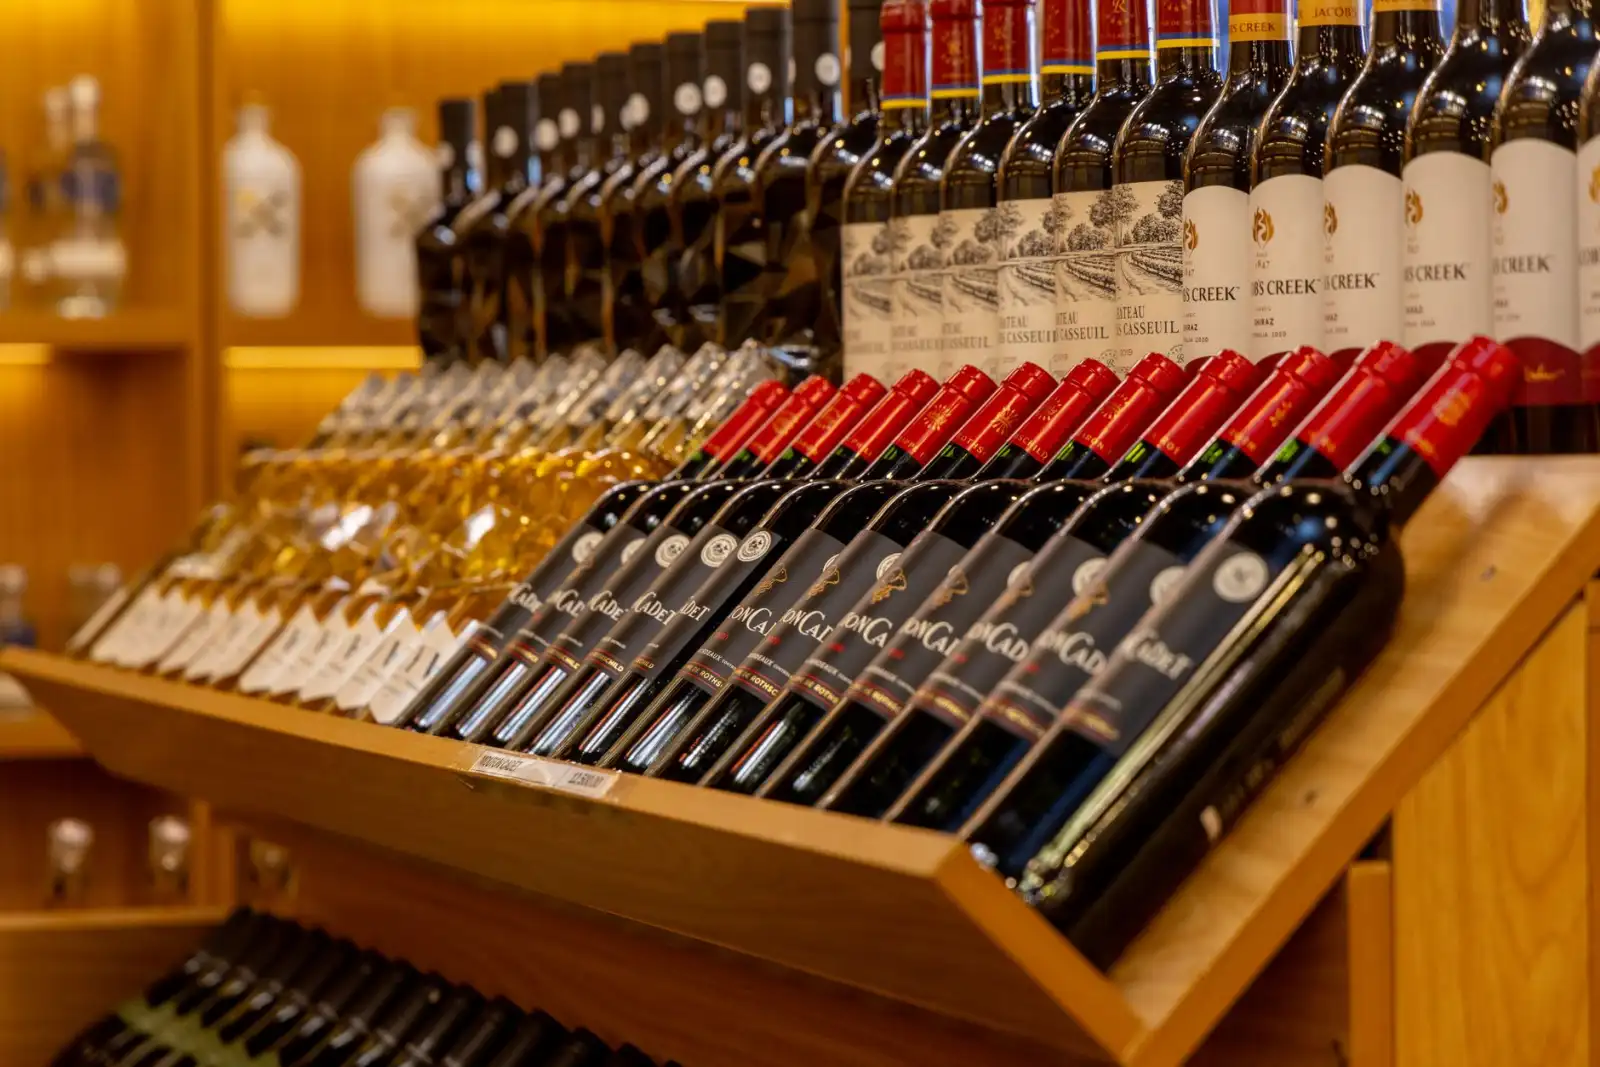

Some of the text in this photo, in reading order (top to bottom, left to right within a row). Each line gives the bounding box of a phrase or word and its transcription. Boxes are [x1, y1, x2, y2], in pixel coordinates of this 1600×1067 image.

[1239, 21, 1276, 33] CREEK
[1415, 263, 1467, 282] CREEK
[1501, 254, 1551, 274] CREEK
[1266, 278, 1318, 296] CREEK
[1330, 272, 1377, 291] CREEK
[1191, 286, 1237, 302] CREEK
[1123, 320, 1180, 336] CASSEUIL
[700, 670, 724, 688] ROTHS
